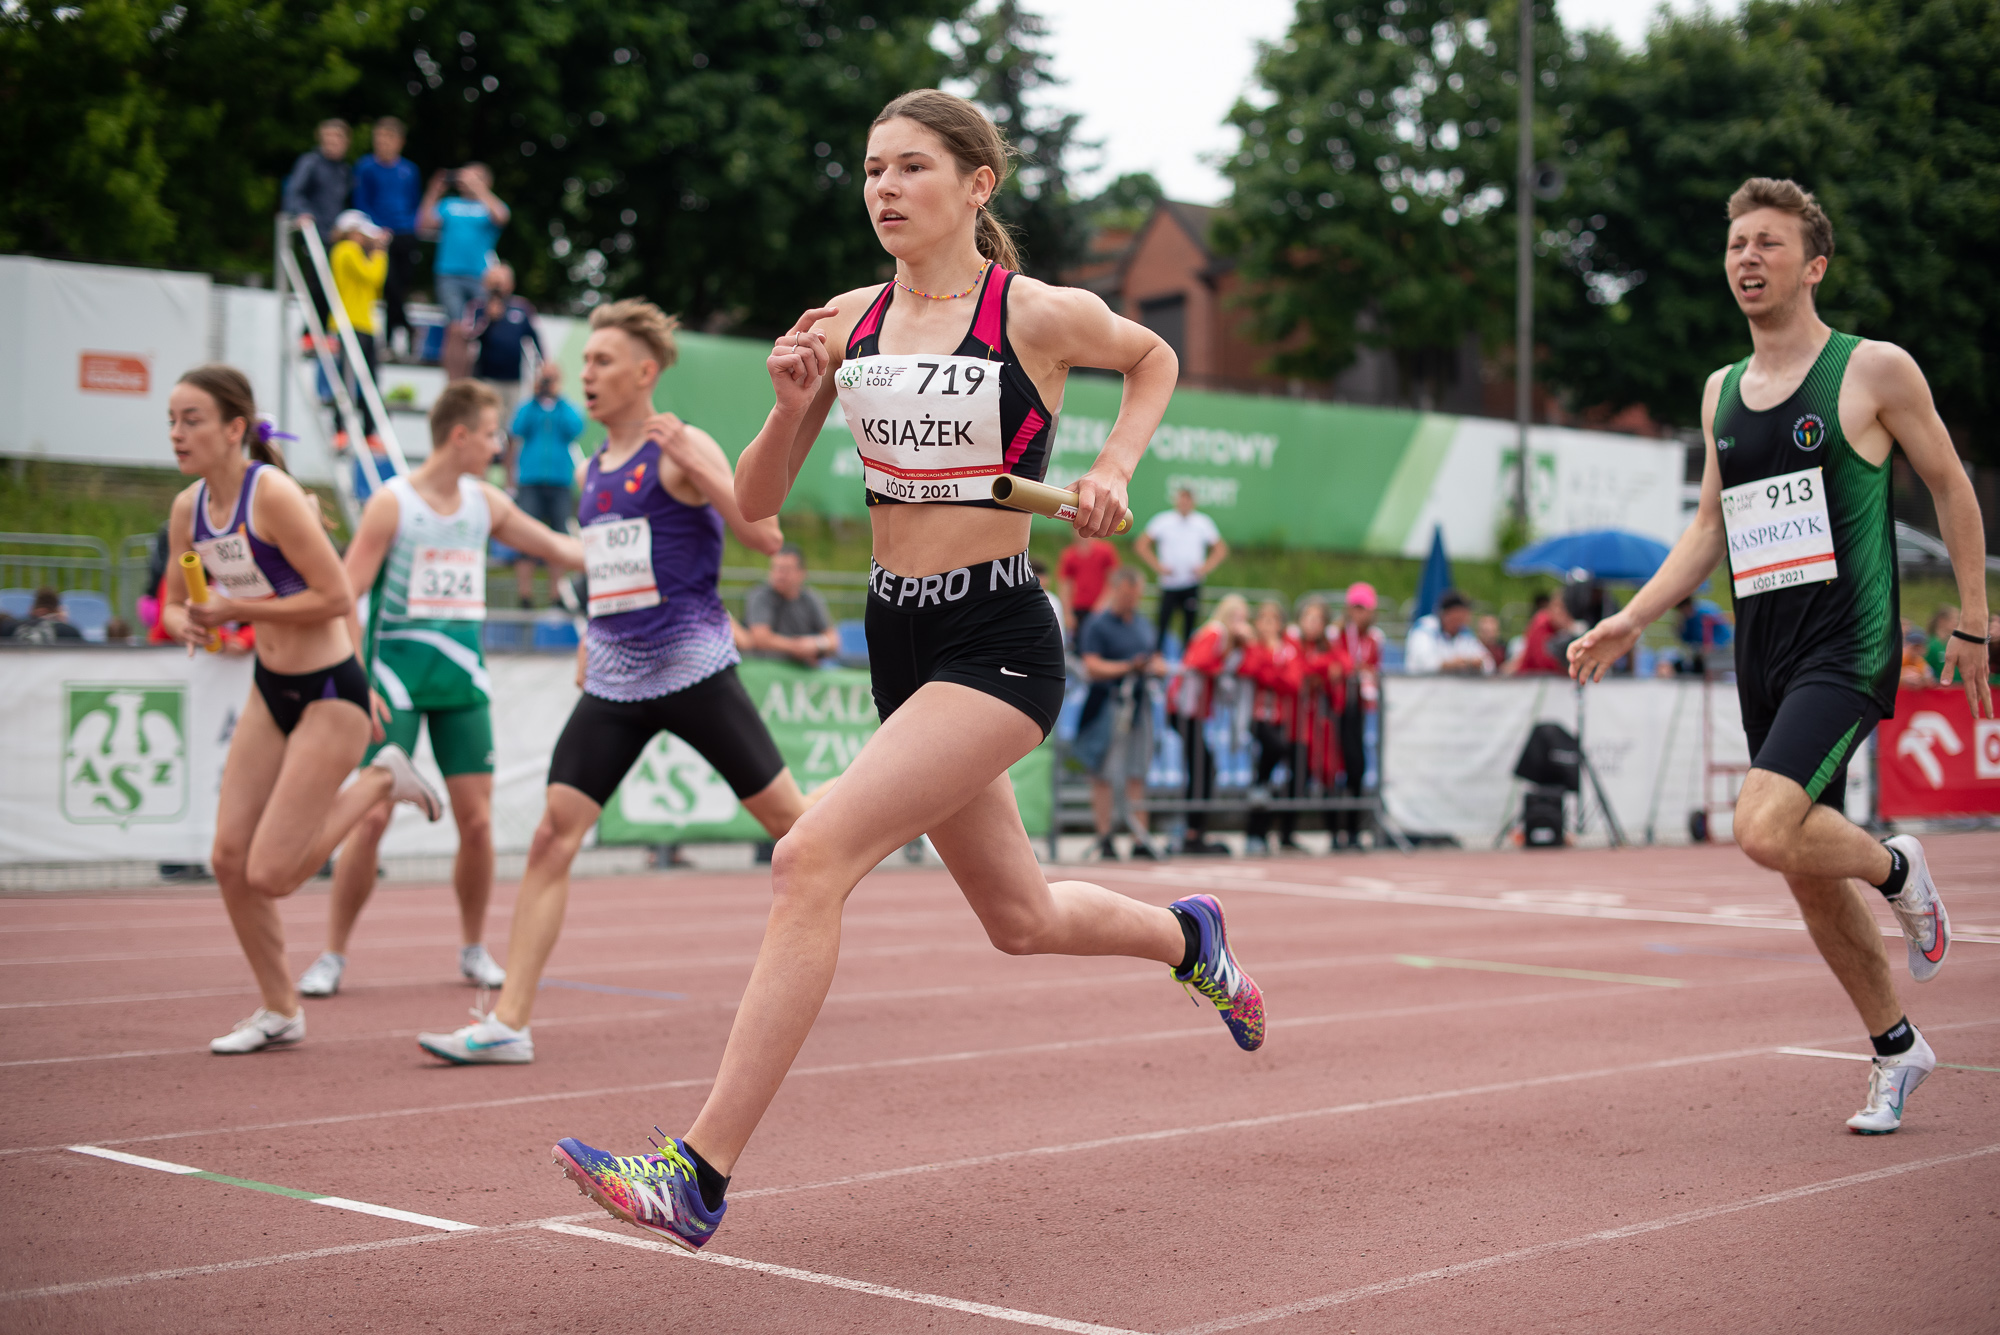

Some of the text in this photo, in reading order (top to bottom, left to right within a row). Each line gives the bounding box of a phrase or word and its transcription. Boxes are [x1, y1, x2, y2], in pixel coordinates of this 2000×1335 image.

[866, 374, 893, 387] ŁÓDŹ
[917, 362, 985, 396] 719
[861, 413, 975, 452] KSIĄŻEK
[885, 477, 960, 499] ŁÓDŹ 2021
[1766, 477, 1814, 509] 913
[606, 525, 642, 548] 807
[1729, 515, 1825, 553] KASPRZYK
[215, 540, 245, 563] 802
[423, 568, 472, 597] 324
[897, 567, 971, 608] PRO
[989, 548, 1035, 592] NIK
[1780, 569, 1804, 585] 2021
[760, 680, 878, 724] AKAD
